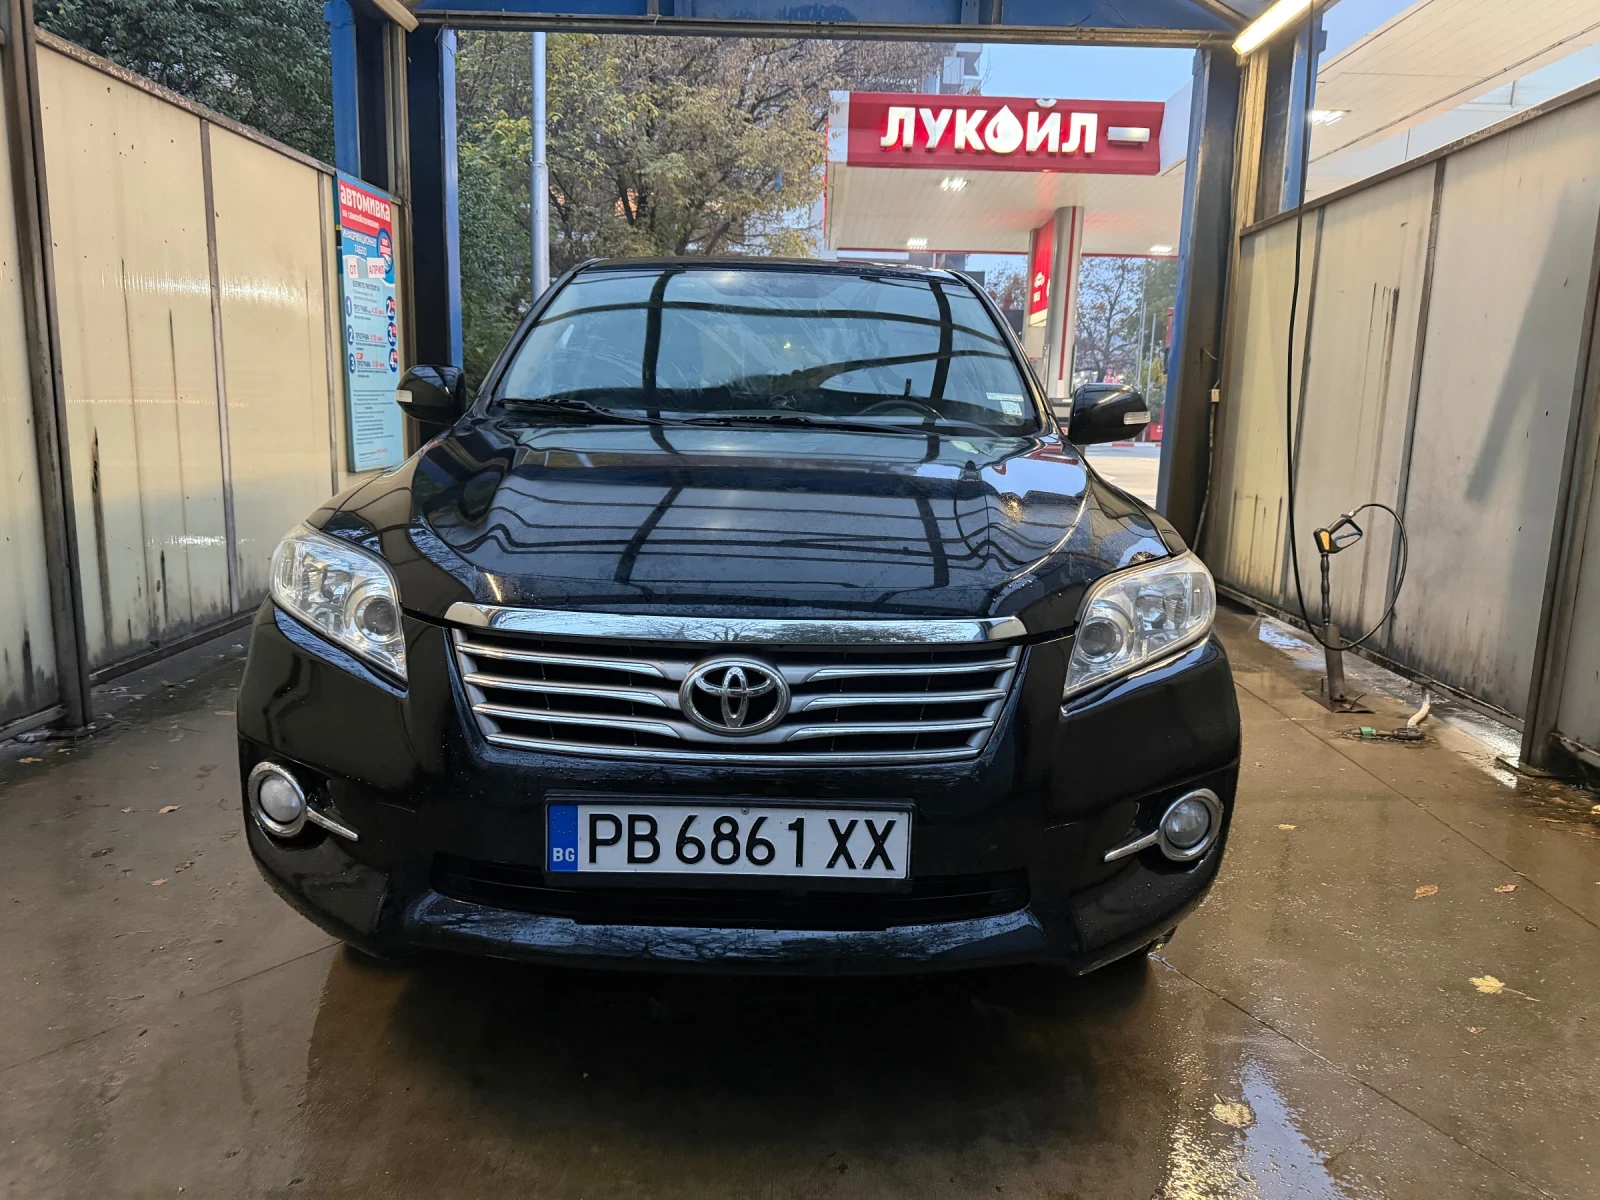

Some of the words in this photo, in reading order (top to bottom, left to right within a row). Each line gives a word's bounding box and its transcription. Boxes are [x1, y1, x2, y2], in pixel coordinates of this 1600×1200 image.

[880, 97, 1098, 155] ЛУКОЙЛ
[552, 847, 576, 863] BG
[588, 813, 661, 864] PB
[675, 814, 806, 868] 6861
[825, 817, 897, 871] XX
